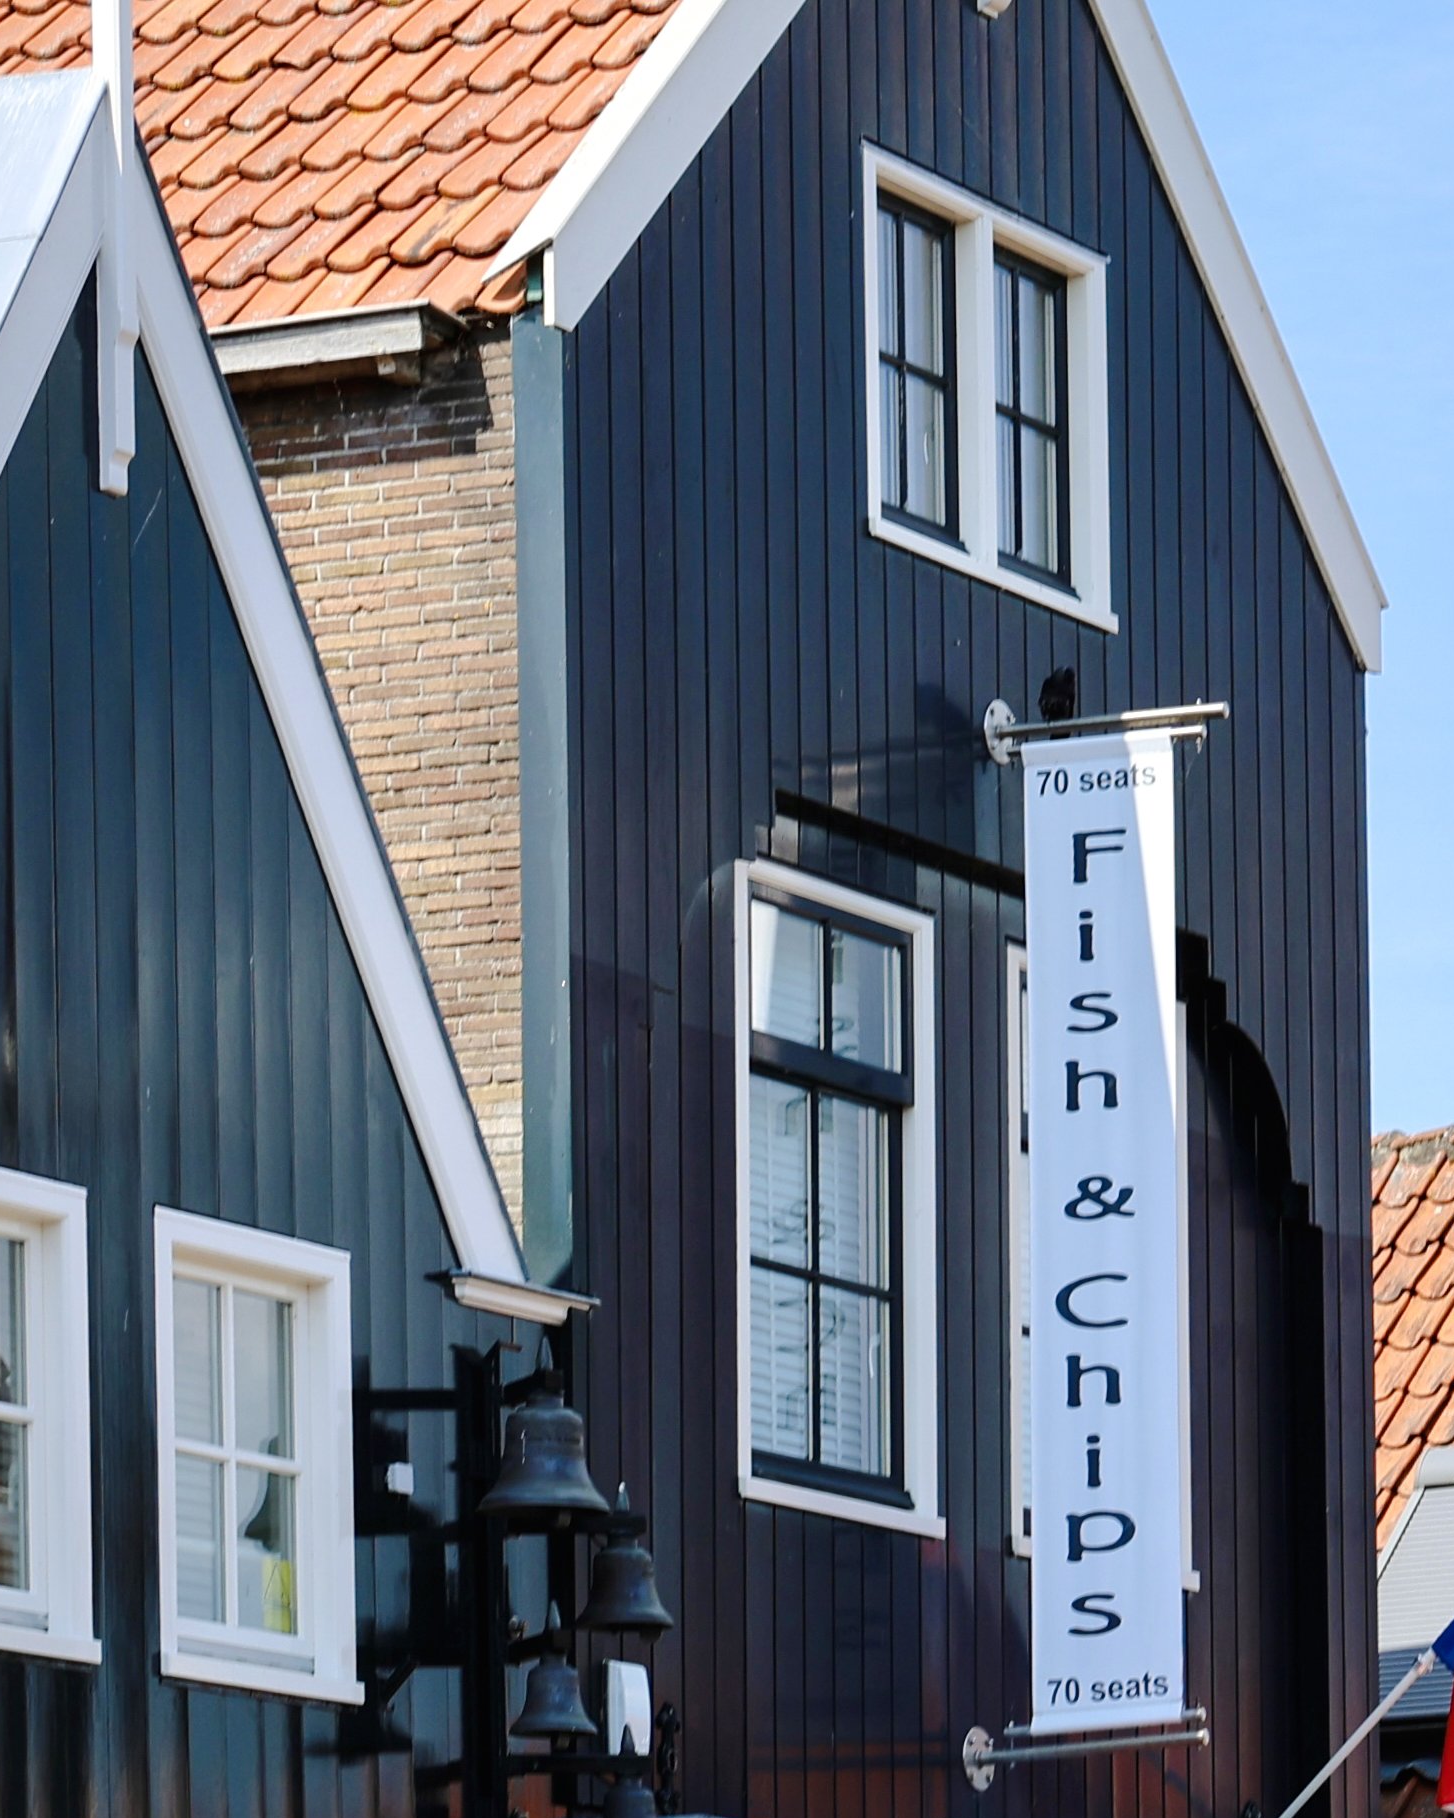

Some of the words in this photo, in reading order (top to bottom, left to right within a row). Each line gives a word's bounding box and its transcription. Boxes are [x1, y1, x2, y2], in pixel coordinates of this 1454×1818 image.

[1037, 770, 1069, 796] 70
[1079, 762, 1156, 792] seats
[1064, 829, 1127, 1111] Fish
[1064, 1175, 1134, 1220] &
[1054, 1272, 1136, 1637] Chips
[1047, 1680, 1080, 1704] 70
[1091, 1672, 1169, 1701] seats
